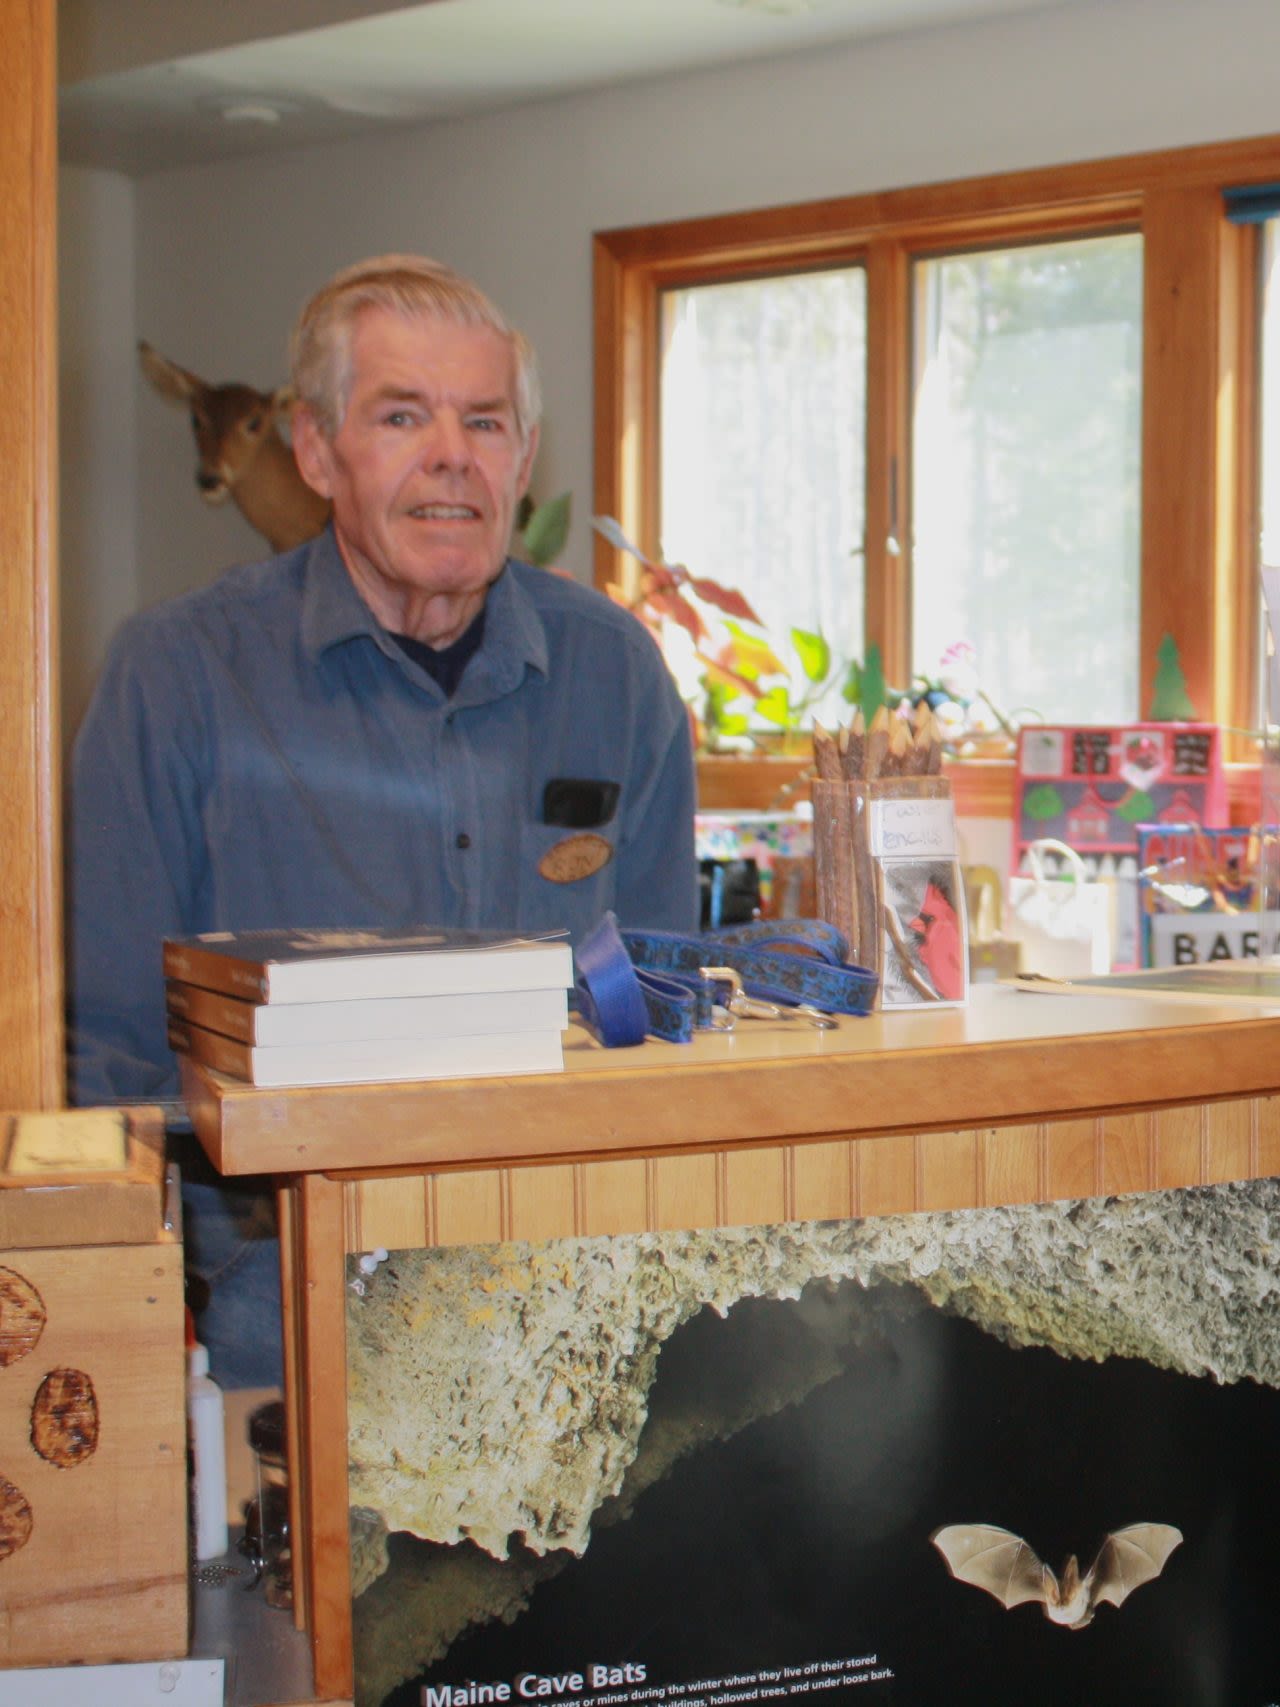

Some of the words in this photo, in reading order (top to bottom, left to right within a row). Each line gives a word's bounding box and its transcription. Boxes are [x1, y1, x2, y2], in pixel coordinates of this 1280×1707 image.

[424, 1681, 511, 1707] Maine
[519, 1672, 584, 1698] Cave
[592, 1662, 647, 1688] Bats
[583, 1698, 595, 1706] or
[597, 1693, 628, 1705] mines
[631, 1688, 665, 1699] during
[668, 1684, 685, 1695] the
[688, 1679, 721, 1692] winter
[725, 1674, 756, 1687] where
[759, 1670, 781, 1681] they
[784, 1667, 801, 1678] live
[804, 1663, 819, 1675] off
[821, 1660, 844, 1672] their
[846, 1654, 877, 1668] stored
[711, 1688, 758, 1705] hollowed
[761, 1686, 787, 1698] trees,
[791, 1681, 809, 1693] and
[812, 1678, 841, 1689] under
[843, 1673, 868, 1685] loose
[871, 1668, 895, 1680] bark.
